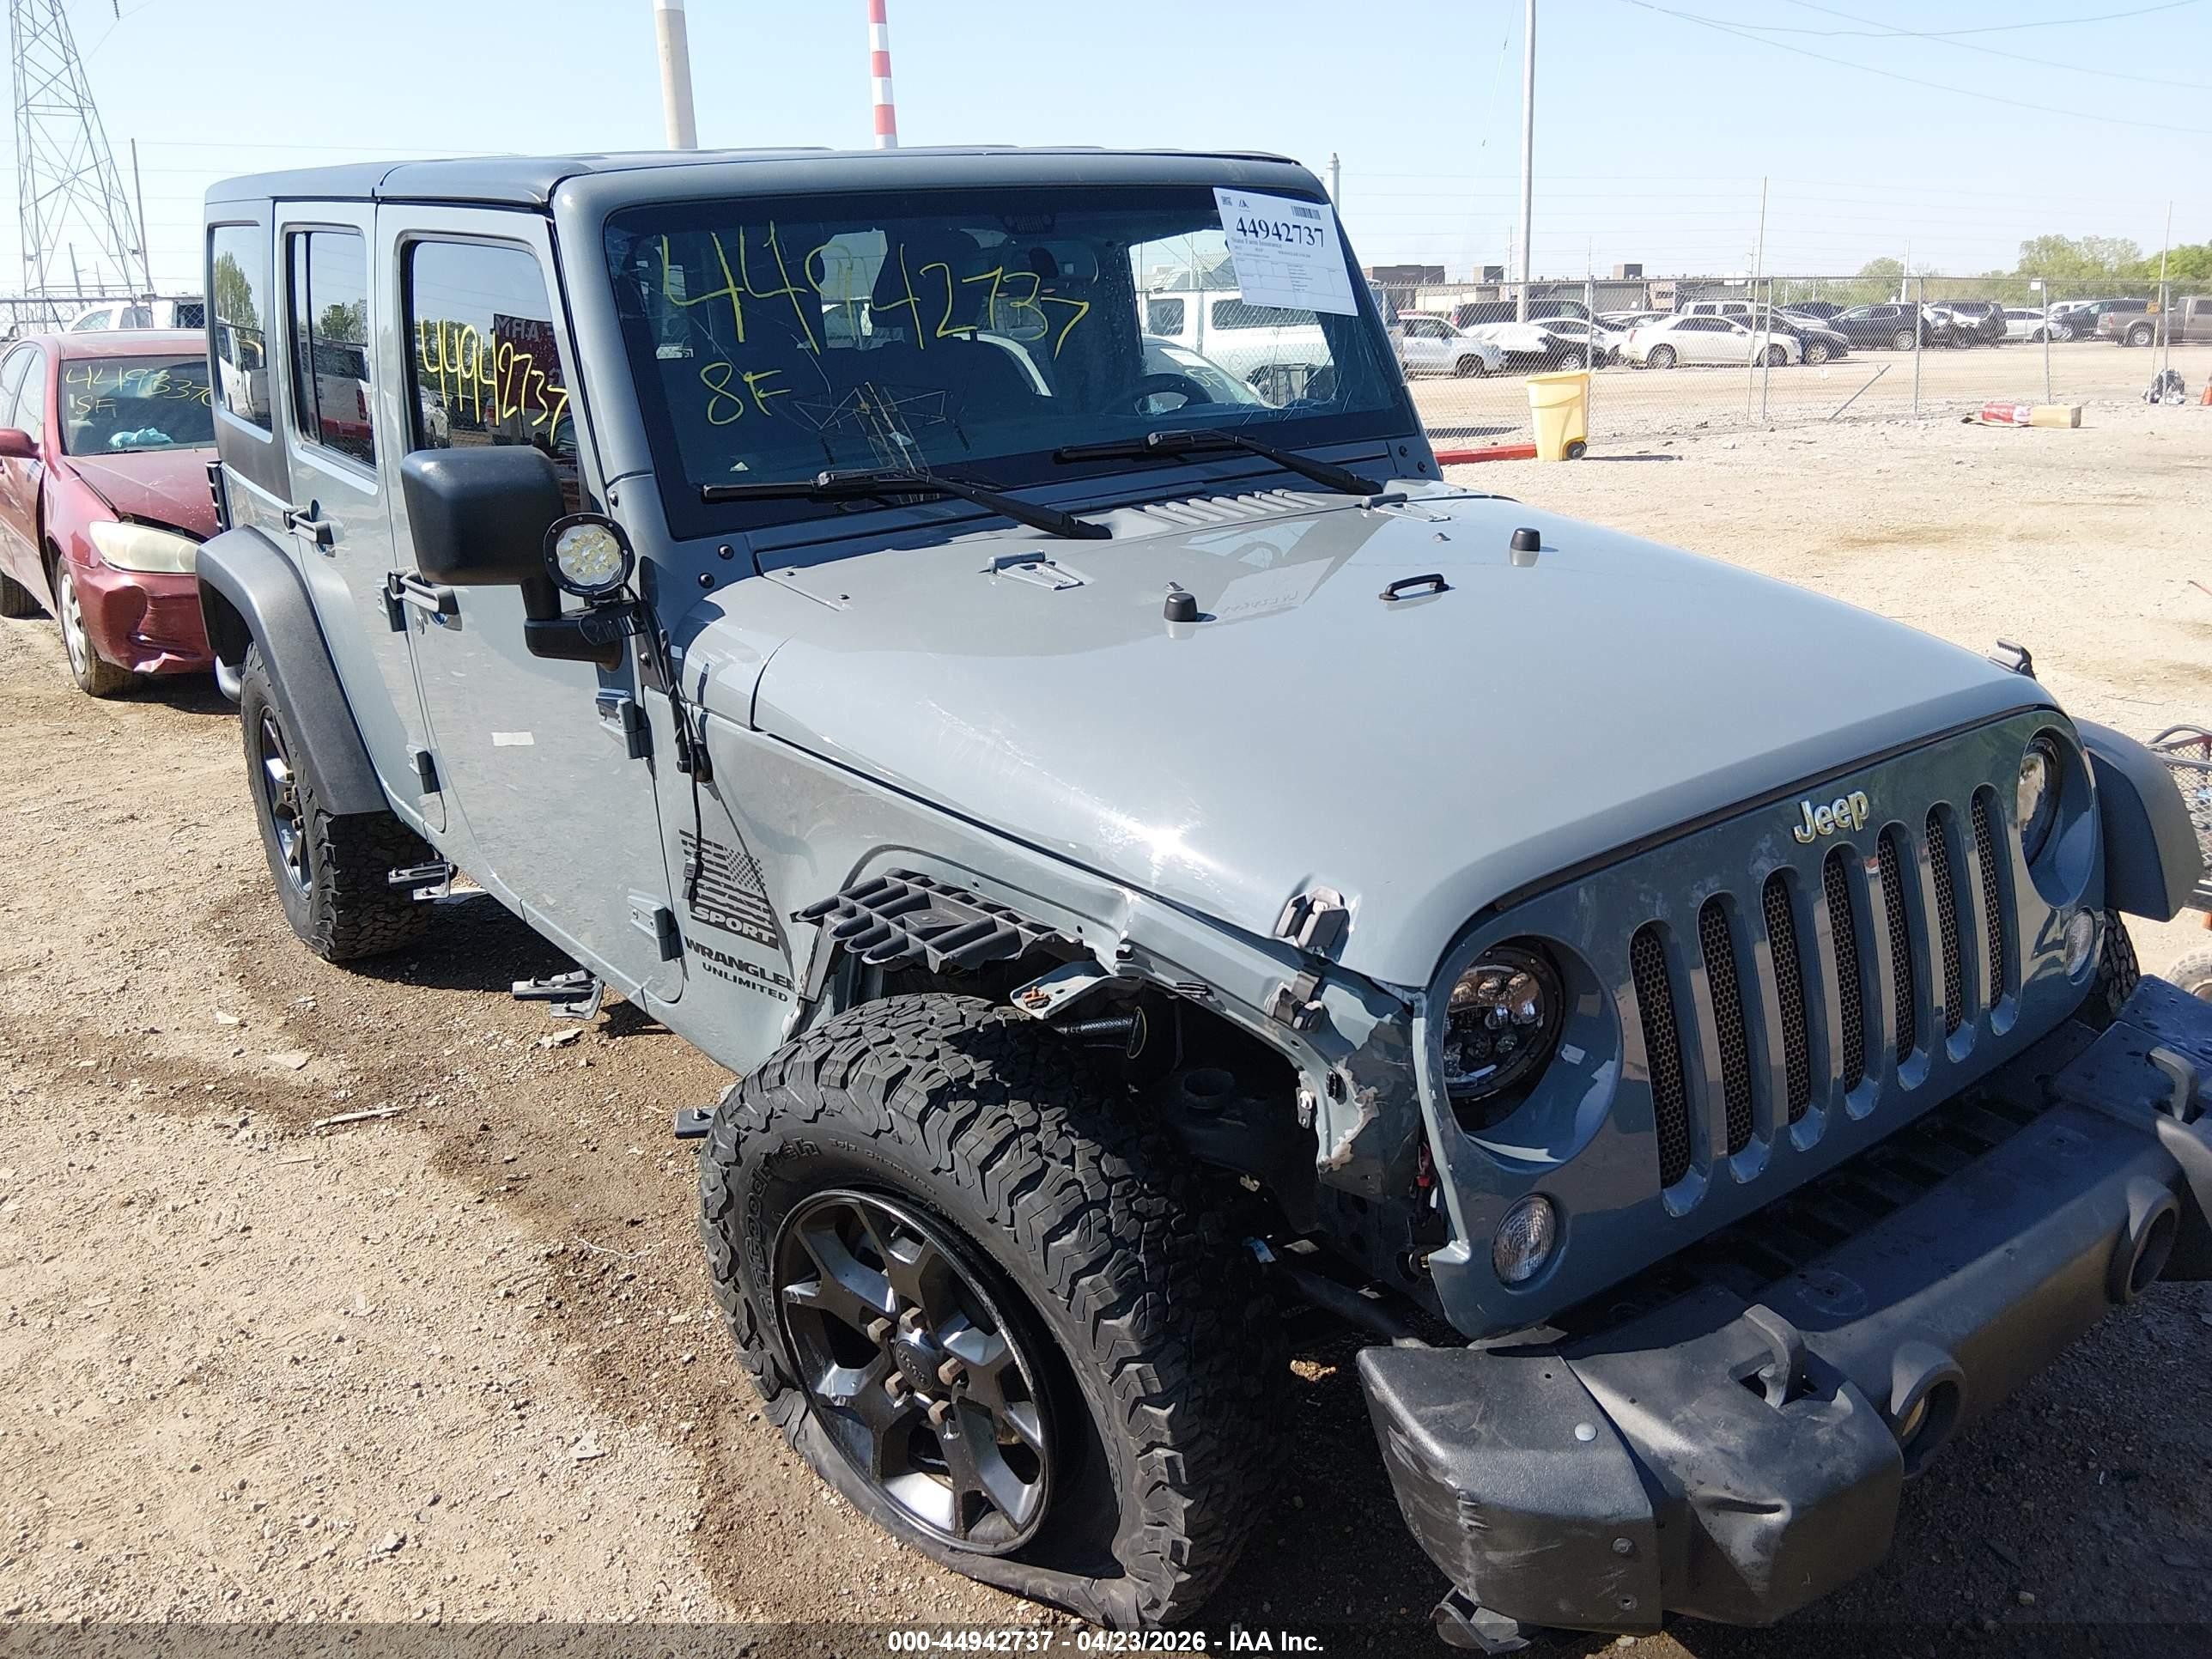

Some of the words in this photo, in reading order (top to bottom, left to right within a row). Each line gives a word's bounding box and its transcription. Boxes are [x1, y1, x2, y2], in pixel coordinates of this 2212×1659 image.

[1236, 216, 1325, 247] 44942737
[661, 221, 1090, 360] 44942737
[420, 315, 569, 447] 44942737
[1794, 790, 1869, 844] Jeep
[694, 906, 777, 943] SPORT
[684, 936, 795, 992] WRANGLER
[702, 962, 788, 1003] UNLIMITED
